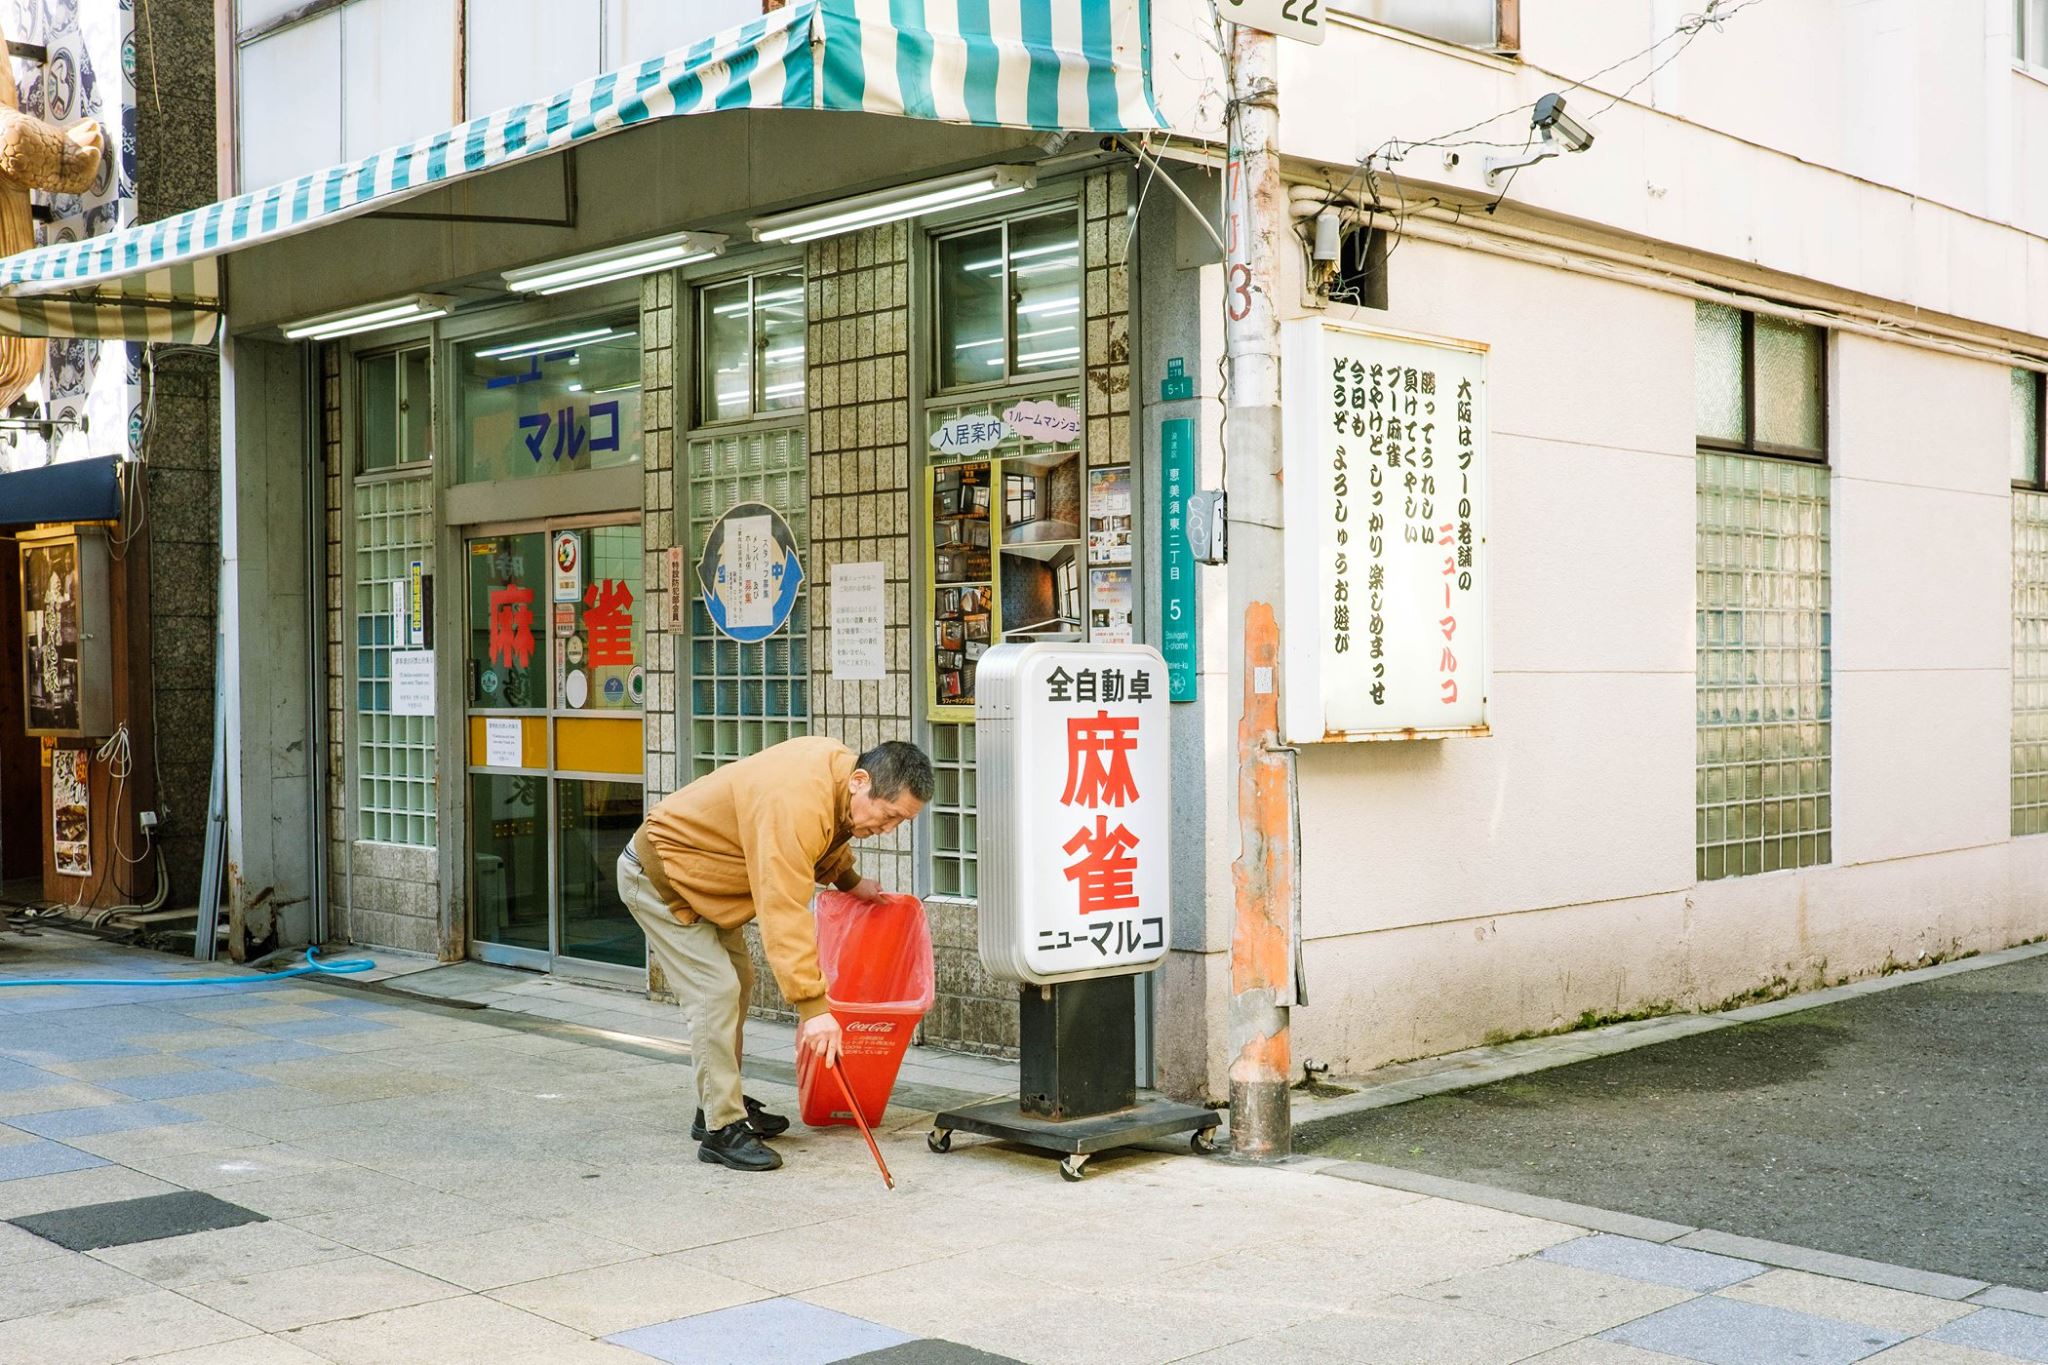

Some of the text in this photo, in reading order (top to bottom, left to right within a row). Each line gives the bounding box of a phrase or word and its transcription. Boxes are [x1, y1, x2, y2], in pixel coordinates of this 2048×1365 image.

[1167, 383, 1184, 395] 5-1
[1349, 360, 1366, 438] 今日も
[518, 400, 619, 462] マルコ
[939, 420, 1002, 447] 入居案内
[1169, 468, 1181, 620] 恵美須東二丁目 5
[1438, 523, 1458, 705] ニューマルコ
[1046, 665, 1153, 704] 全自動卓
[1060, 710, 1141, 915] 麻雀
[1038, 916, 1164, 956] ニューマルコ
